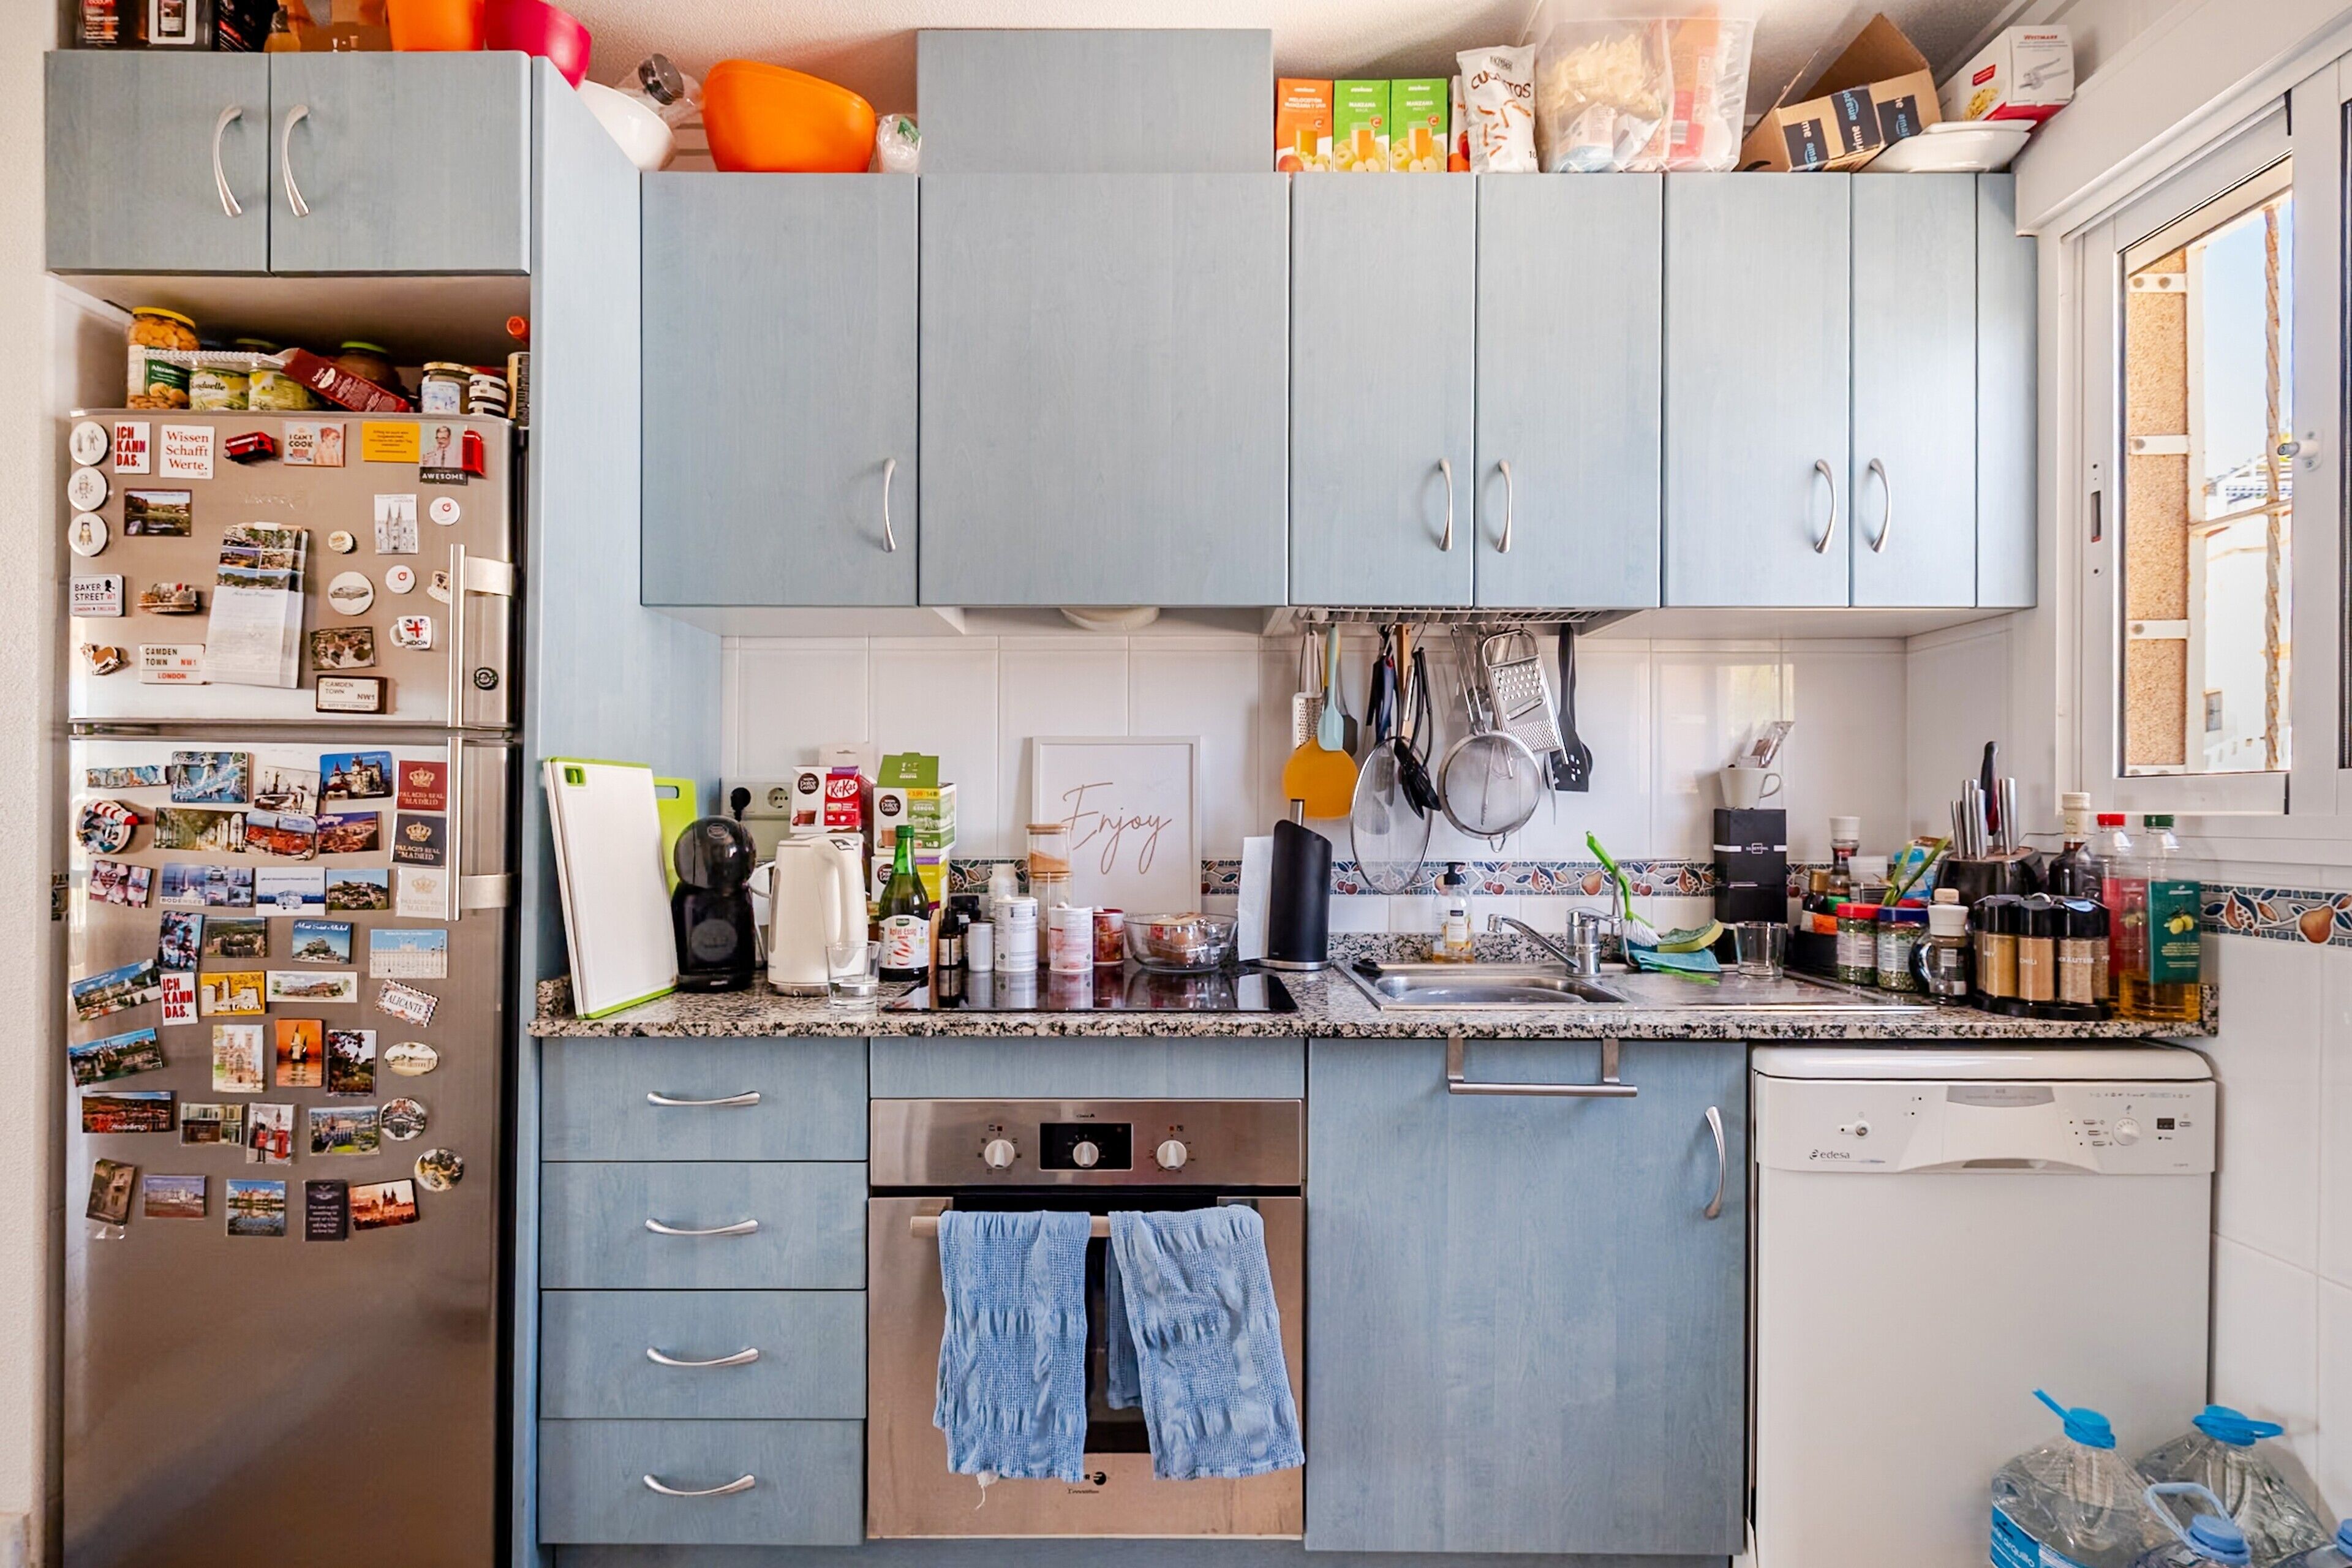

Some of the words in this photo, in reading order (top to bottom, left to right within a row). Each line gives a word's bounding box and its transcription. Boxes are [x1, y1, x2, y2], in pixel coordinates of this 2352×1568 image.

[1842, 89, 1858, 121] amazo
[1852, 125, 1865, 153] rime
[116, 426, 134, 439] ICH
[167, 431, 209, 443] Wissen
[116, 440, 146, 453] KANN
[165, 445, 208, 456] Schafft
[116, 453, 140, 467] DAS.
[168, 458, 208, 470] Werte.
[74, 583, 102, 592] BAKER
[74, 592, 105, 601] STREET
[830, 779, 857, 797] KitKat
[1061, 782, 1172, 875] Enjoy
[401, 851, 434, 861] MADRID
[162, 978, 180, 991] ICH
[163, 990, 194, 1005] KANN
[386, 994, 424, 1014] ALICANTE
[165, 1005, 190, 1019] DAS.
[1820, 1150, 1850, 1159] edesa
